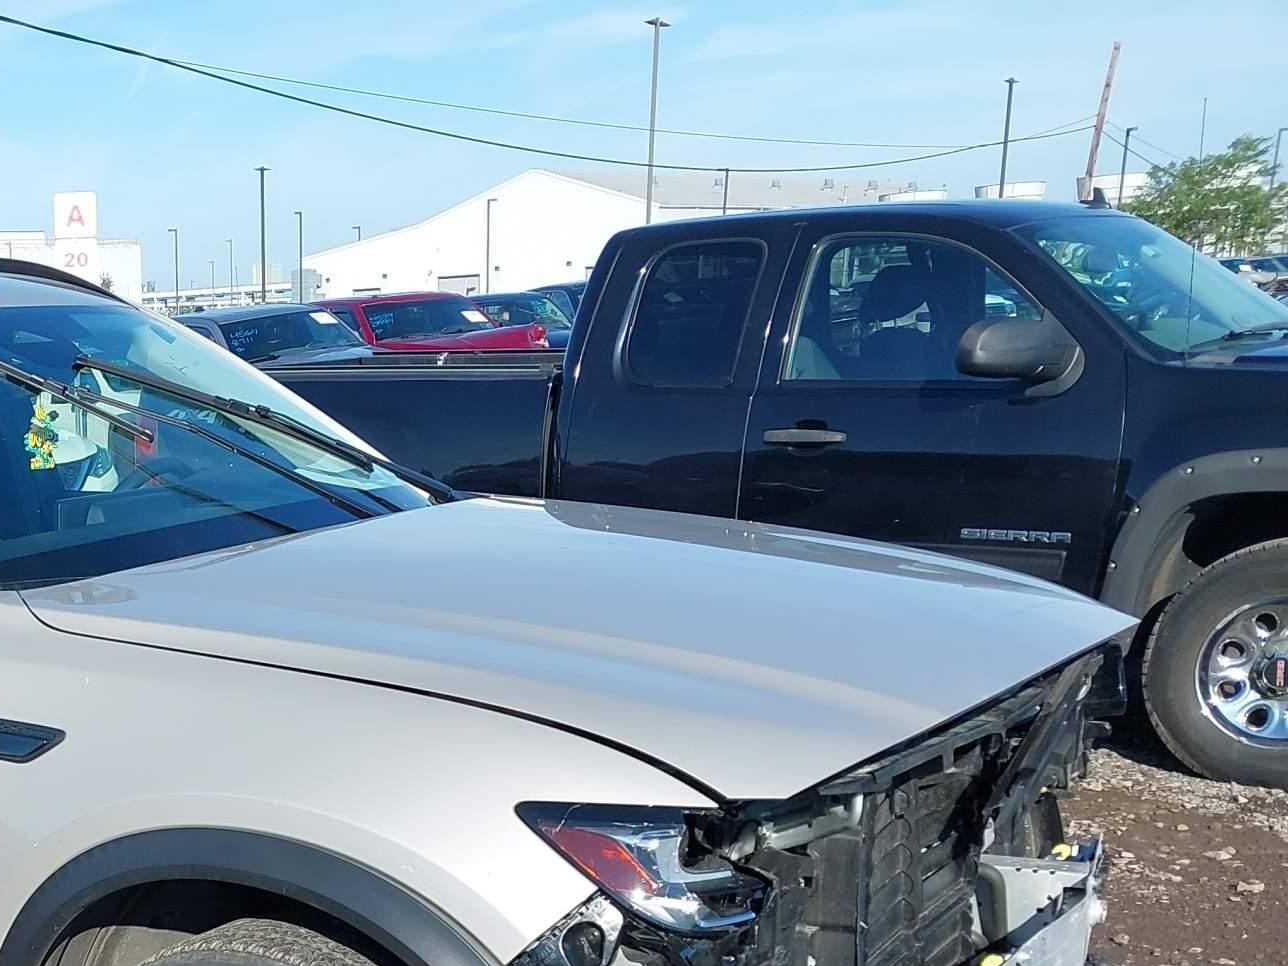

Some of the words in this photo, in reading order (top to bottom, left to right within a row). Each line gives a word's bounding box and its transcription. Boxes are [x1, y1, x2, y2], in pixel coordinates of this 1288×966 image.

[66, 205, 86, 227] A
[63, 251, 89, 268] 20
[959, 527, 1072, 543] SIERRA
